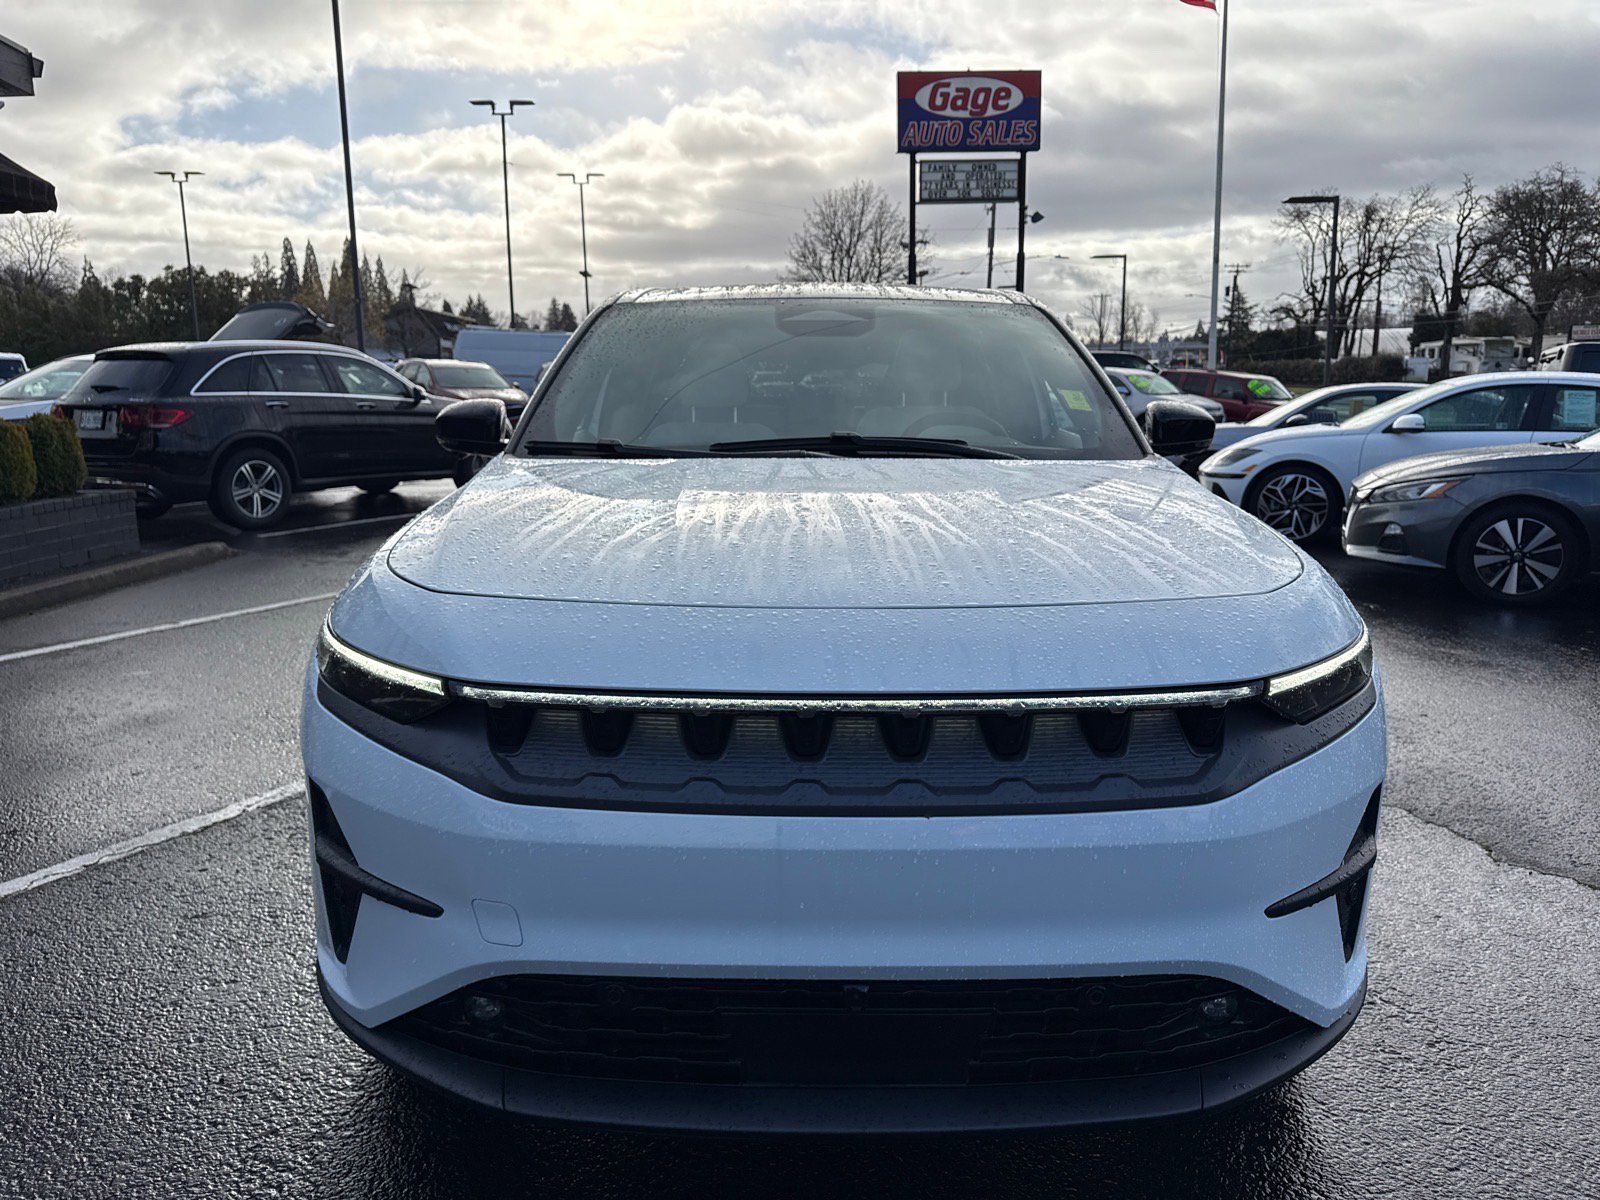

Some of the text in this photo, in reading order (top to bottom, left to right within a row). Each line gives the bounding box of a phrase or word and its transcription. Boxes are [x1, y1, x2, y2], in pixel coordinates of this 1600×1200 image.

[928, 82, 1012, 117] Gage
[902, 119, 1037, 147] AUTO SALES
[928, 163, 997, 172] FAMILY OWNED
[941, 172, 956, 181] AND
[934, 180, 958, 190] YEARS
[962, 180, 971, 190] IN
[928, 190, 948, 199] OVER
